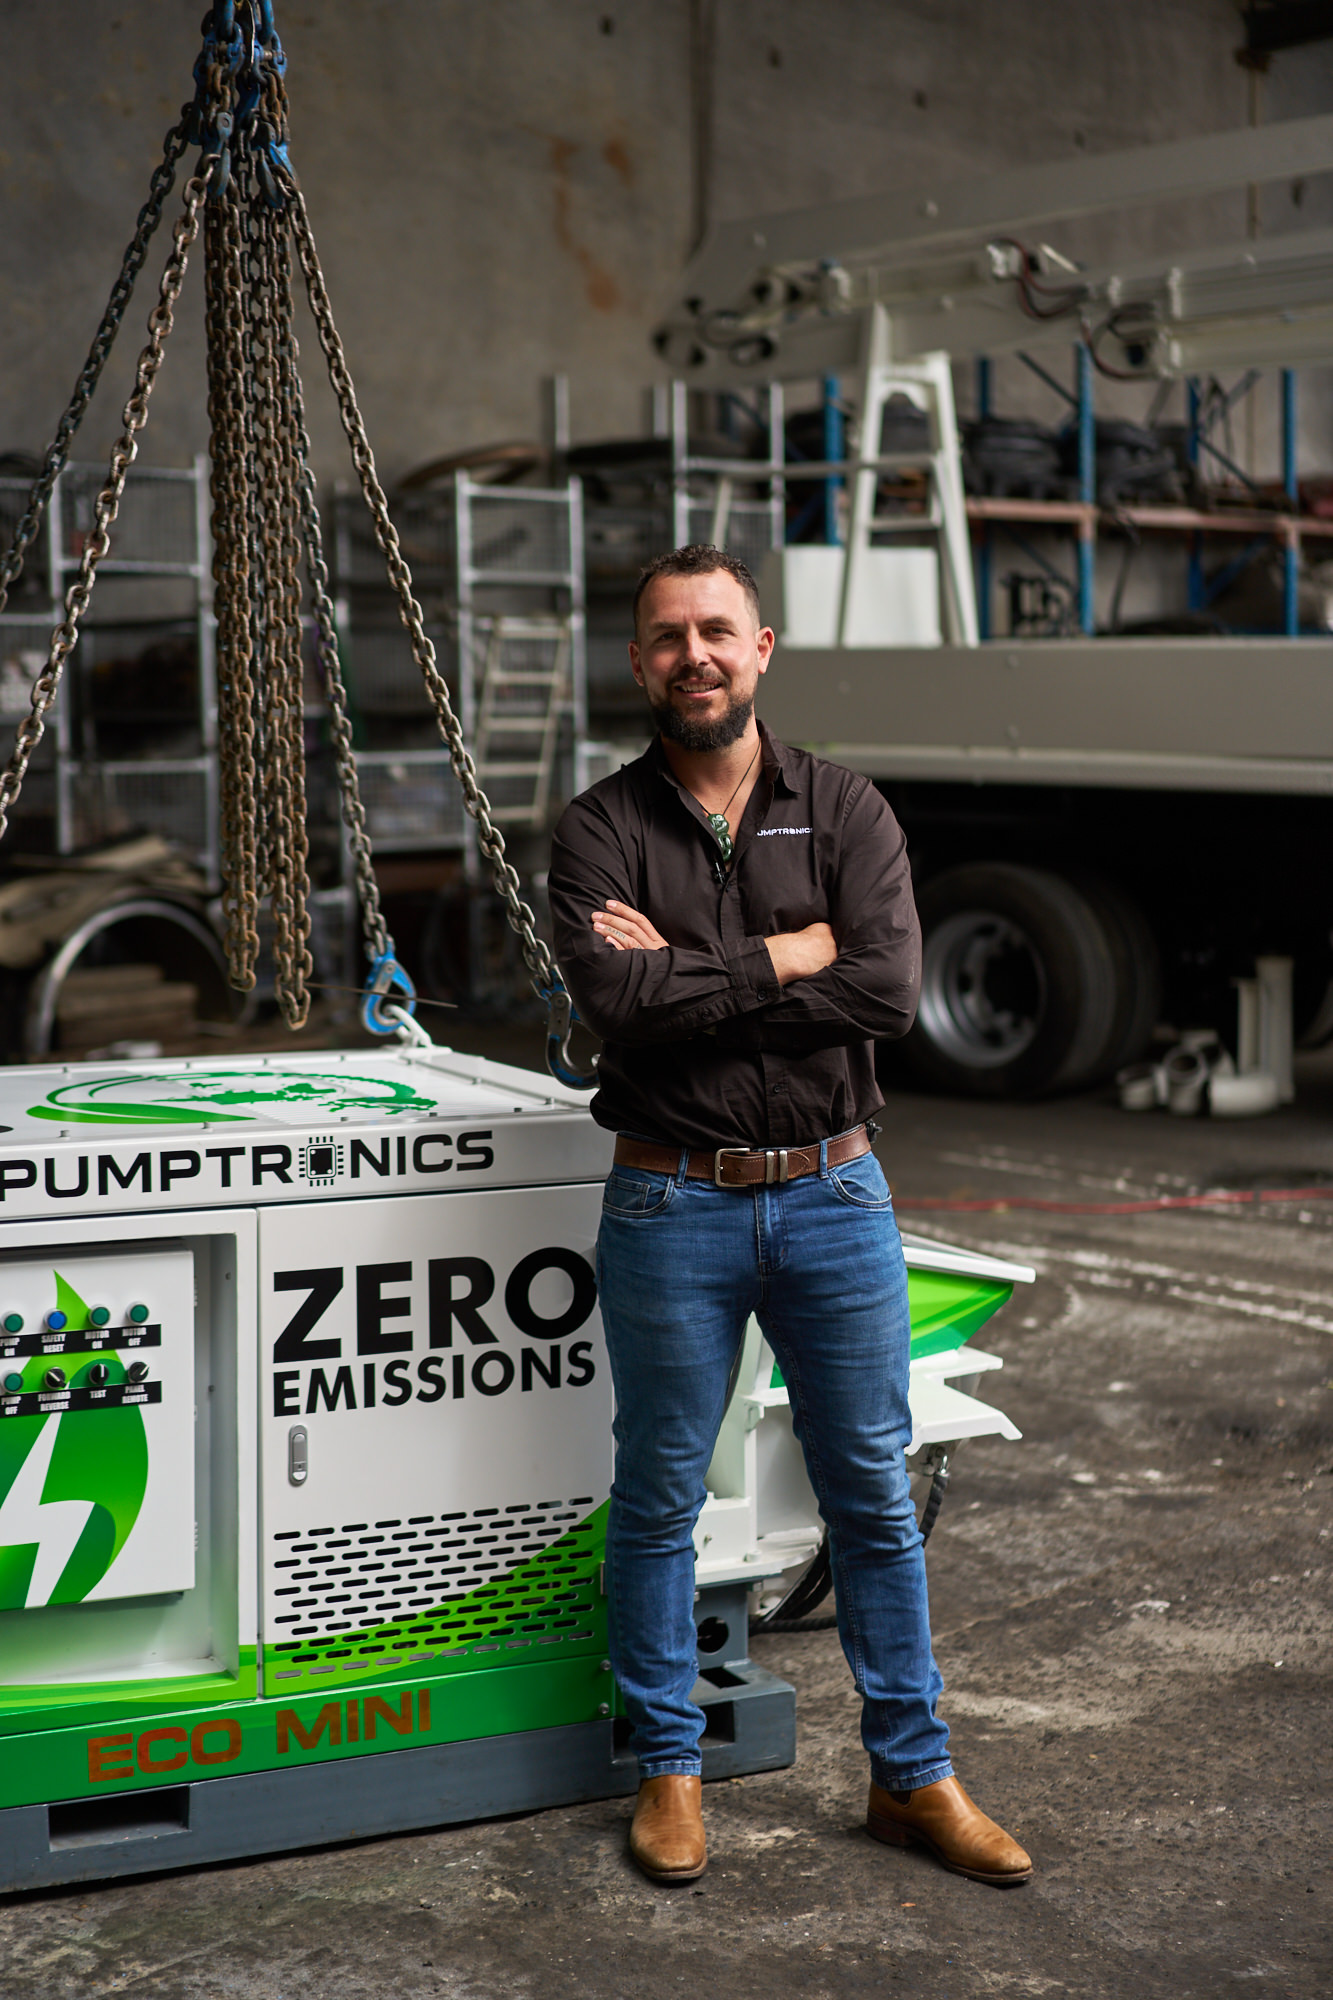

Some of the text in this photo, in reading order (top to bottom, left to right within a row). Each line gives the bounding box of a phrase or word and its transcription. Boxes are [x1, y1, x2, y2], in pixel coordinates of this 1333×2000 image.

[273, 1247, 598, 1363] ZERO
[273, 1341, 595, 1417] EMISSIONS
[87, 1689, 431, 1783] ECO MINI
